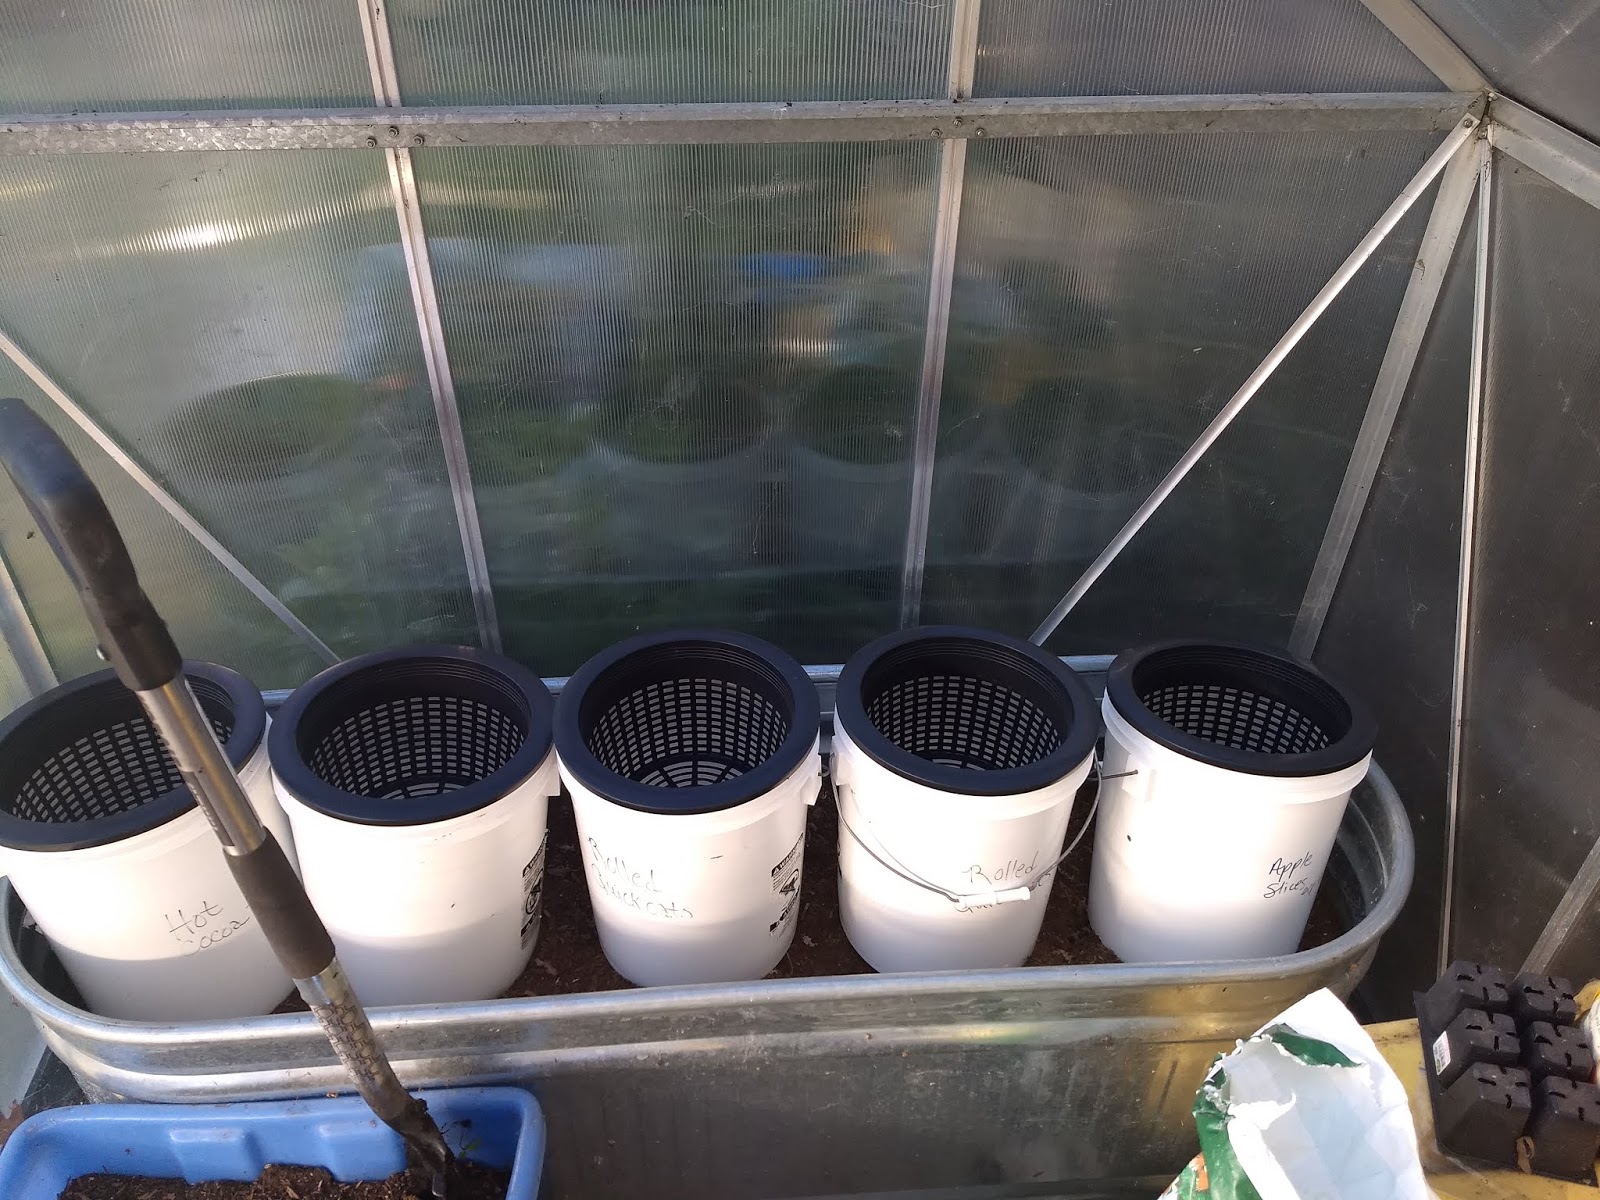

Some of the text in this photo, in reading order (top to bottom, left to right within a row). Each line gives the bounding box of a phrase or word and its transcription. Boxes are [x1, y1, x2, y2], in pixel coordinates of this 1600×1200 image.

[587, 836, 662, 894] Rolled
[960, 850, 1040, 886] Rolled
[1267, 850, 1313, 883] Apple
[1263, 877, 1309, 899] Slices
[164, 900, 224, 941] Hot
